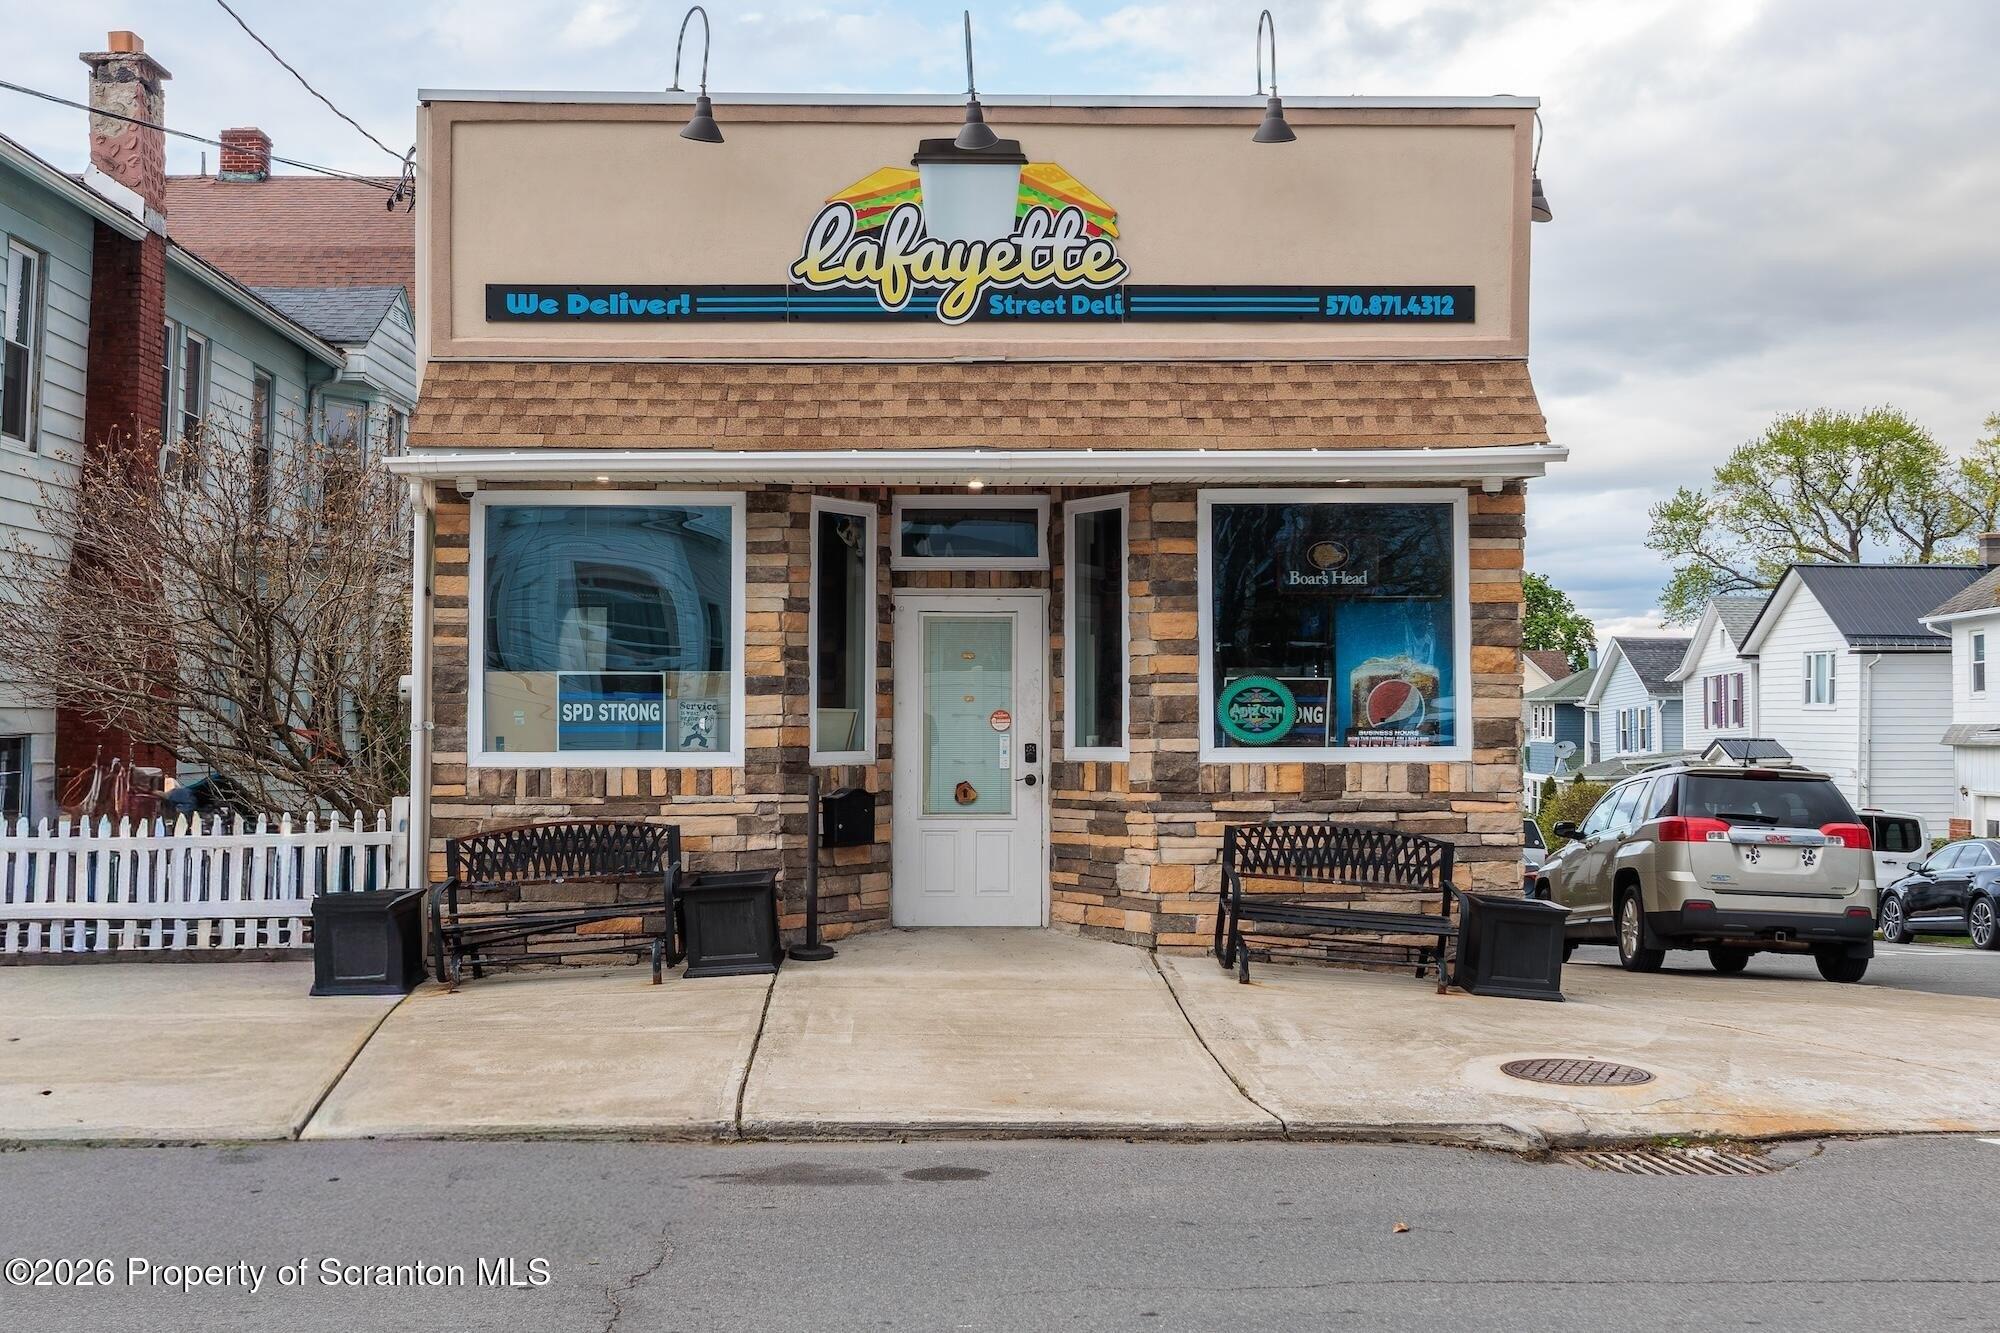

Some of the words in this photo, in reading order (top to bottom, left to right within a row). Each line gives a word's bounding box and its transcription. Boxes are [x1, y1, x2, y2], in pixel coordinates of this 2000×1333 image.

[506, 293, 559, 315] We
[567, 291, 690, 315] Deliver!
[989, 294, 1066, 315] Street
[1071, 294, 1125, 315] Deli
[1326, 295, 1455, 316] 570.871.4312
[1289, 570, 1329, 585] Boar's
[1331, 570, 1368, 585] Head
[562, 703, 594, 721] SPD
[599, 703, 660, 721] STRONG
[680, 701, 719, 711] Service
[1765, 834, 1792, 844] GMC
